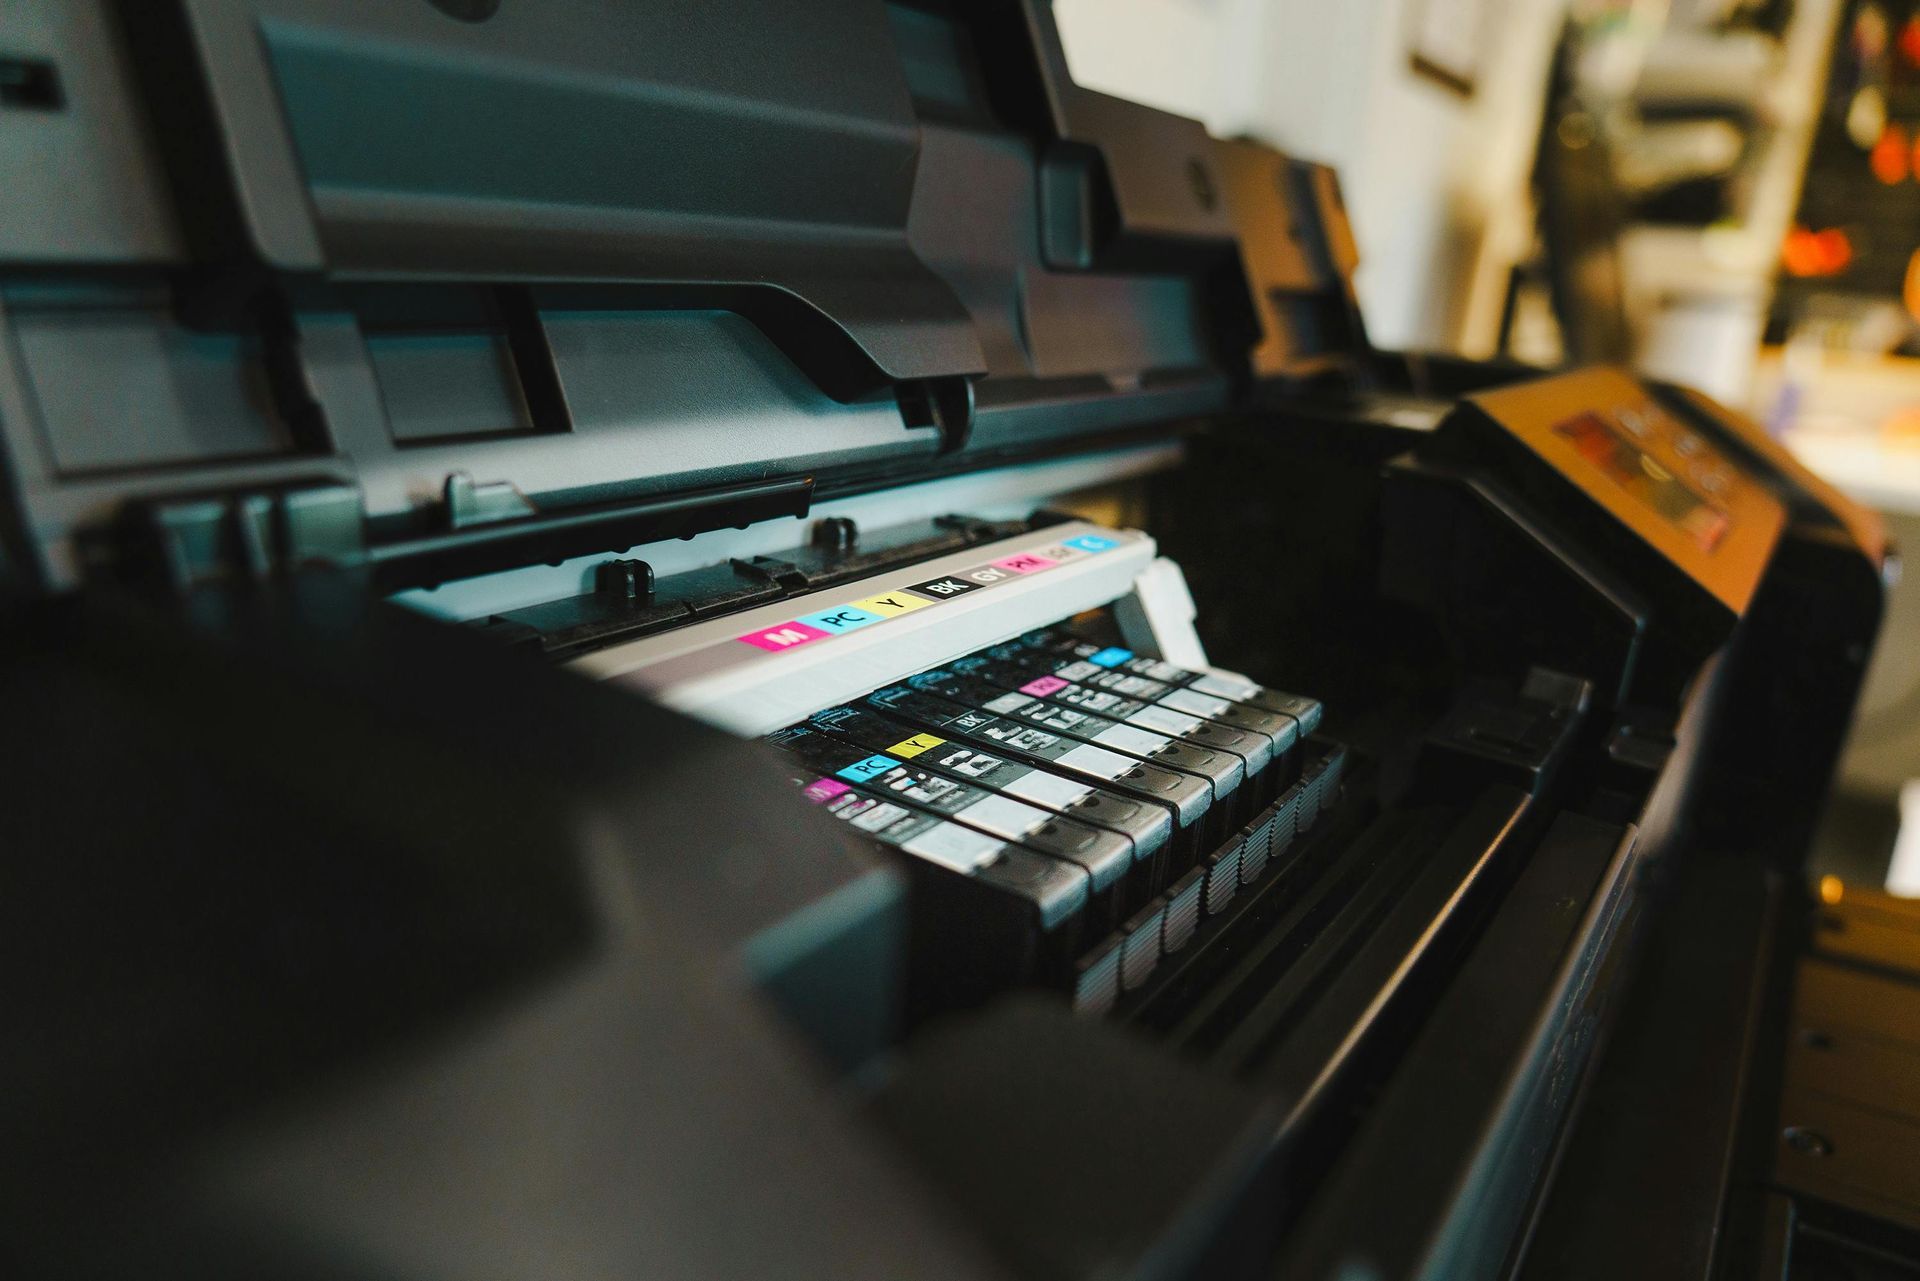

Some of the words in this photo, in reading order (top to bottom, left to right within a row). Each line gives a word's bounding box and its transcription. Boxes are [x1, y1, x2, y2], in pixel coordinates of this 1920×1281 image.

[764, 628, 809, 646] M
[820, 611, 866, 627] PC
[876, 598, 904, 608] Y
[926, 580, 969, 595] BK
[971, 567, 1007, 582] GY
[956, 714, 986, 728] BK
[906, 740, 926, 748] Y
[855, 760, 886, 774] PC
